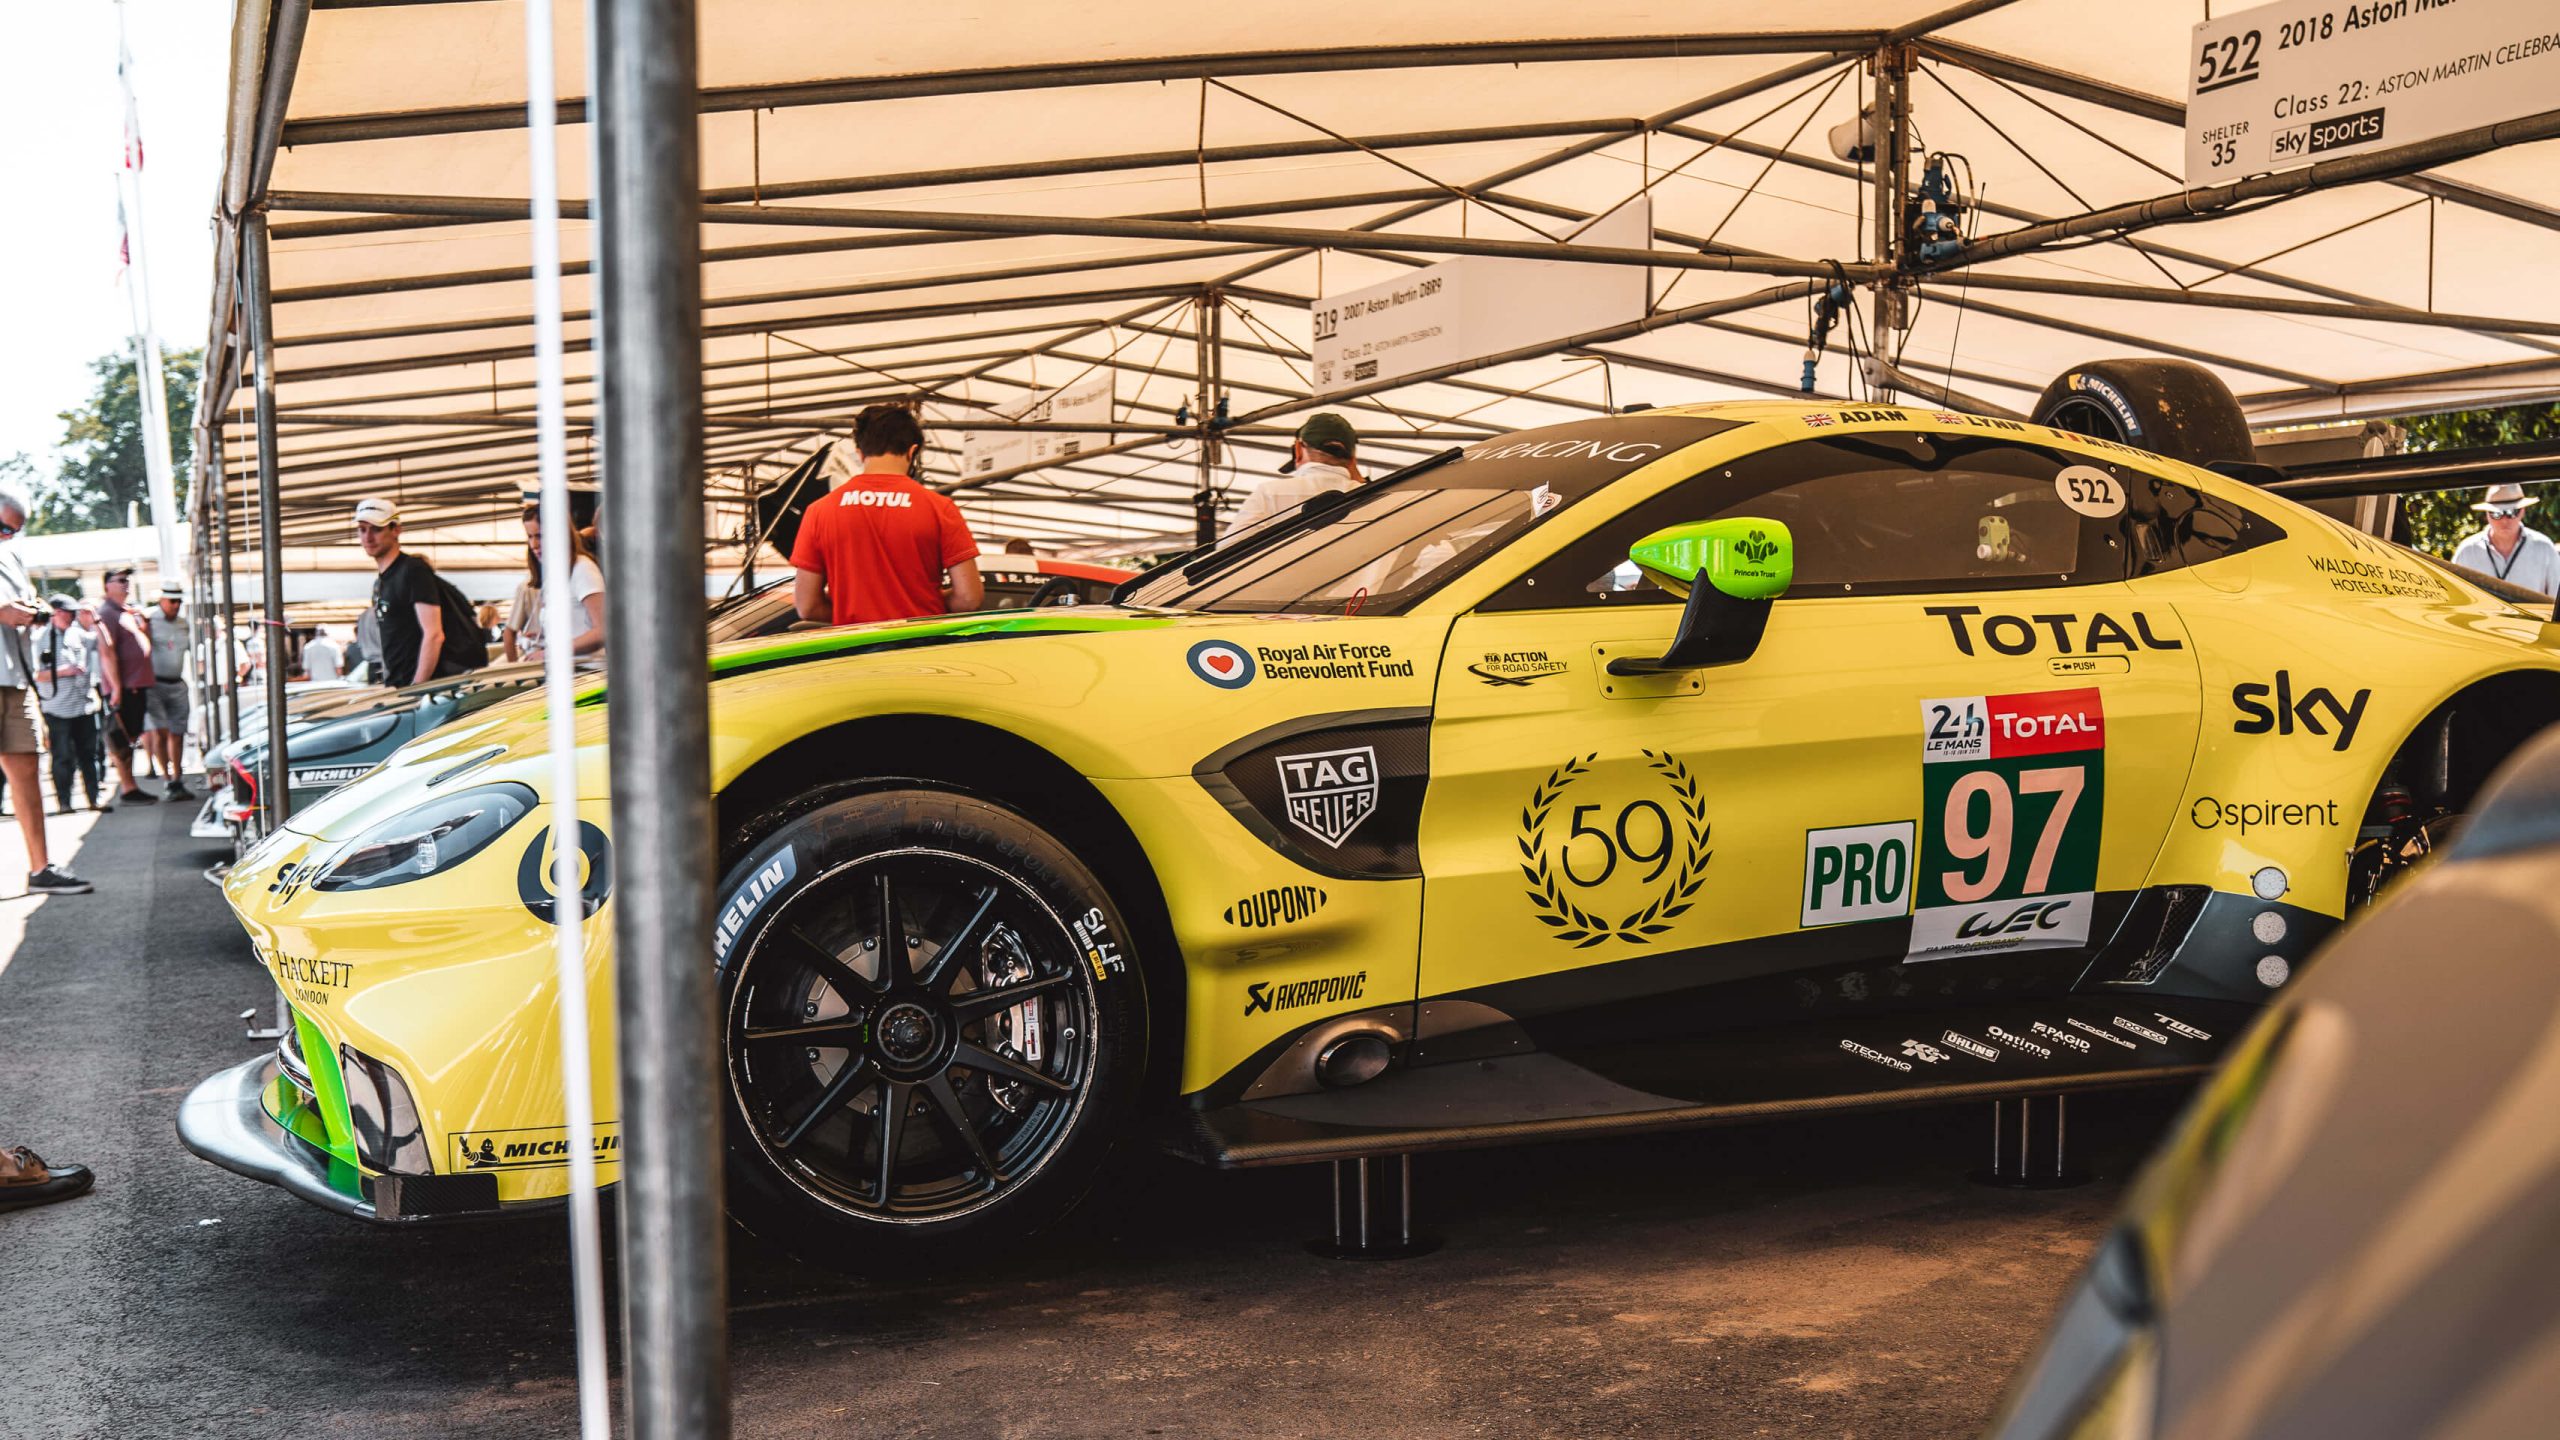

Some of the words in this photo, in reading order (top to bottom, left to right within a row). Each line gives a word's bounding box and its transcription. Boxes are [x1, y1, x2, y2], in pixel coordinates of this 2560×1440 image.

[2279, 13, 2334, 50] 2018
[2343, 0, 2408, 33] Aston
[2197, 29, 2263, 84] 522
[2274, 95, 2329, 119] Class
[2338, 81, 2370, 106] 22:
[2376, 67, 2430, 96] ASTON
[2433, 51, 2492, 82] MARTIN
[2202, 122, 2250, 145] SHELTER
[2275, 130, 2307, 154] sky
[2313, 114, 2380, 147] sports
[2211, 141, 2236, 167] 35
[1314, 309, 1338, 336] 519
[1344, 302, 1365, 320] 2007
[1840, 410, 1908, 424] ADAM
[2087, 377, 2138, 431] MICHELIN
[1966, 414, 2026, 432] LYNN
[1495, 440, 1662, 463] RACING
[840, 490, 912, 508] MOTUL
[2067, 477, 2115, 505] 522
[1734, 568, 1759, 577] Prince's
[1760, 570, 1776, 578] Trust
[2307, 555, 2384, 579] WALDORF
[2389, 568, 2448, 591] ASTORIA
[2330, 578, 2383, 595] HOTELS
[2382, 584, 2394, 596] &
[1923, 605, 2184, 657] TOTAL
[1257, 646, 1311, 664] Royal
[1313, 644, 1338, 660] Air
[1339, 643, 1392, 659] Force
[1484, 654, 1501, 663] FIA
[1503, 651, 1549, 663] ACTION
[1486, 664, 1501, 672] FOR
[1502, 663, 1530, 673] ROAD
[1531, 661, 1568, 672] SAFETY
[2073, 662, 2096, 670] PUSH
[1264, 661, 1367, 680] Benevolent
[1368, 659, 1415, 679] Fund
[1929, 702, 1985, 740] 24h
[2231, 669, 2372, 752] sky
[1995, 712, 2097, 739] TOTAL
[1926, 741, 1943, 751] LE
[1944, 739, 1982, 750] MANS
[1286, 755, 1369, 789] TAG
[1291, 790, 1371, 840] HEUER
[1562, 800, 1674, 888] 59
[1941, 765, 2086, 902] 97
[1810, 838, 1907, 911] PRO
[1238, 885, 1317, 928] DUPONT
[1955, 900, 2072, 939] WEC
[275, 950, 354, 988] HACKETT
[295, 988, 329, 1006] LONDON
[1946, 1033, 1997, 1059] ÖHLINS
[1987, 1025, 2051, 1057] Ontime
[2046, 1026, 2091, 1050] PAGID
